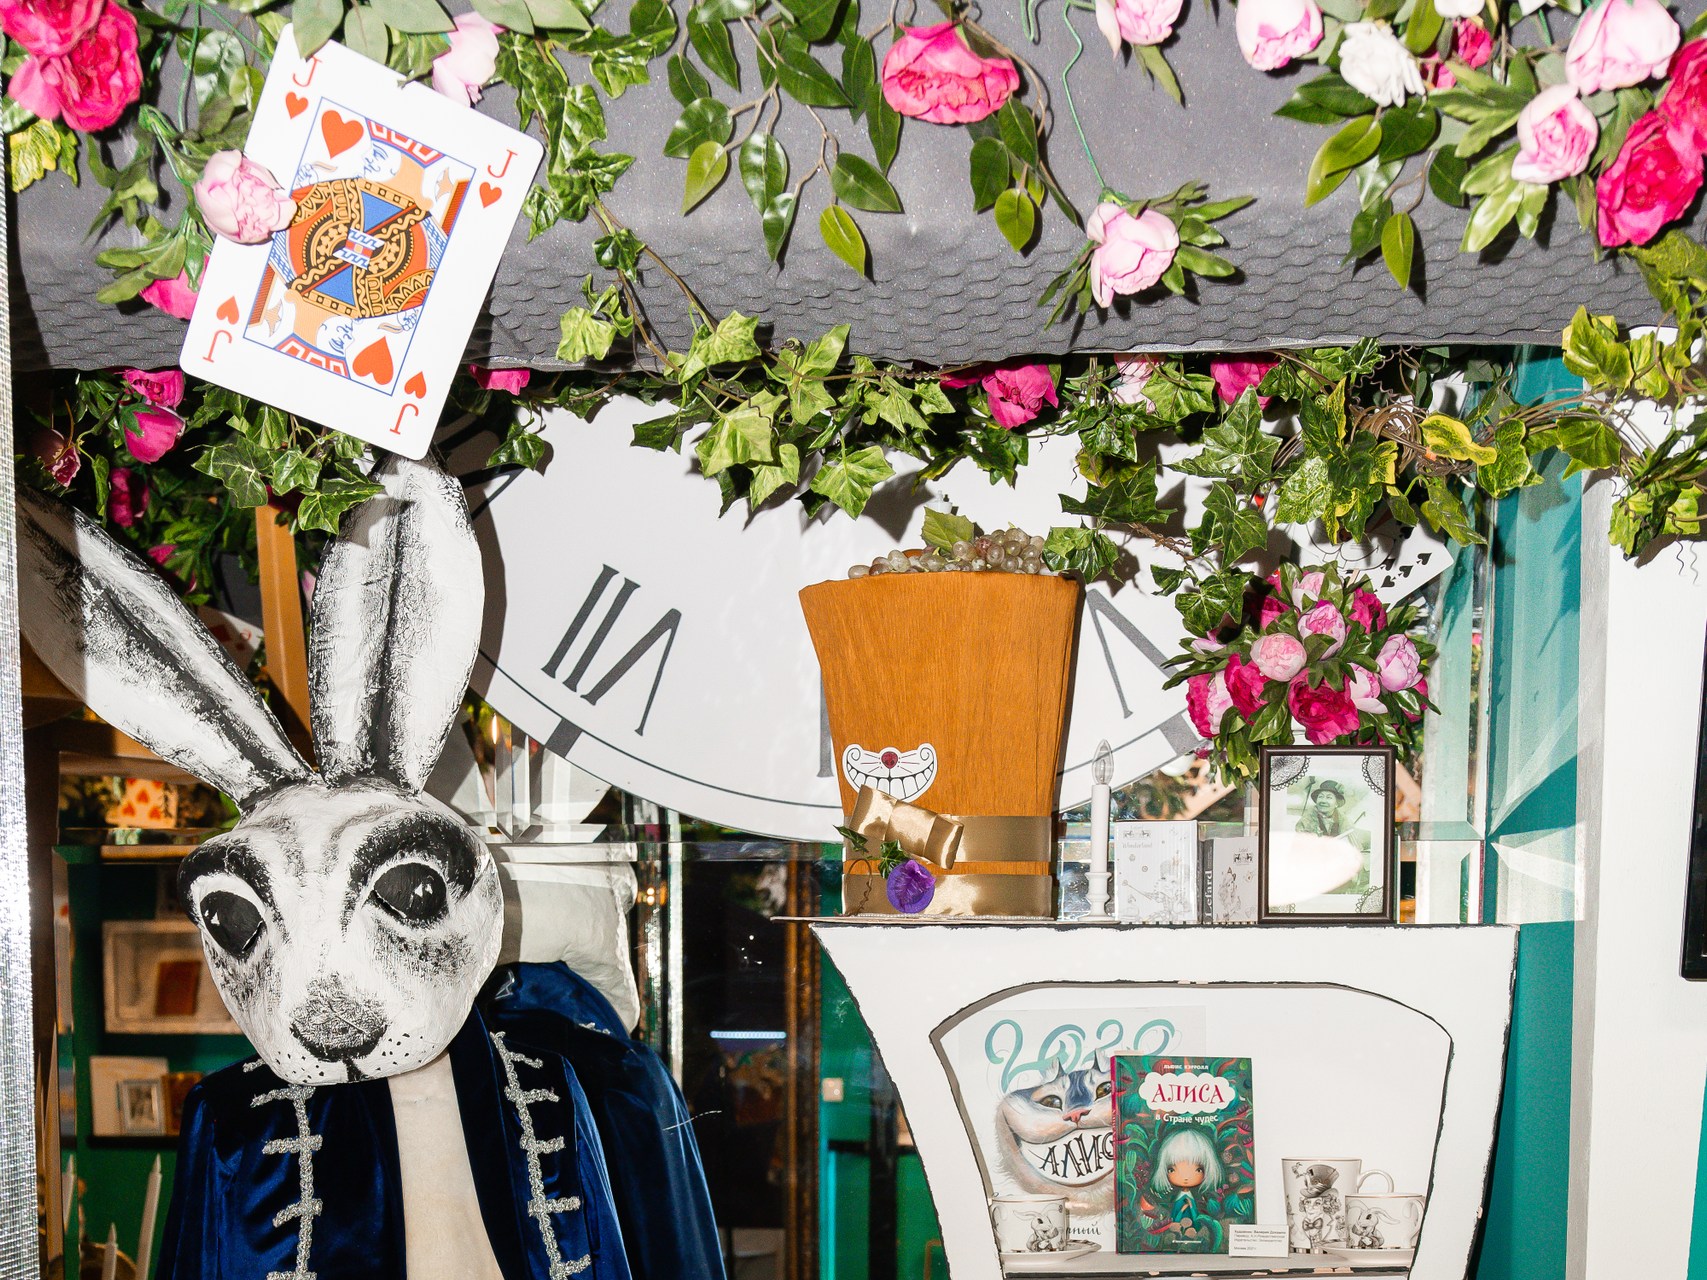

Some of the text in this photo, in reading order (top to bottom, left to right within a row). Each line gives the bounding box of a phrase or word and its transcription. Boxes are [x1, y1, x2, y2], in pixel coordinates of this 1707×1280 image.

[293, 56, 322, 88] J
[487, 149, 518, 179] J
[202, 329, 232, 364] J
[389, 403, 419, 435] J
[1204, 869, 1213, 917] Lefard
[1151, 1083, 1226, 1104] АЛИСА
[1163, 1113, 1193, 1125] Стране
[1195, 1114, 1219, 1126] чудес
